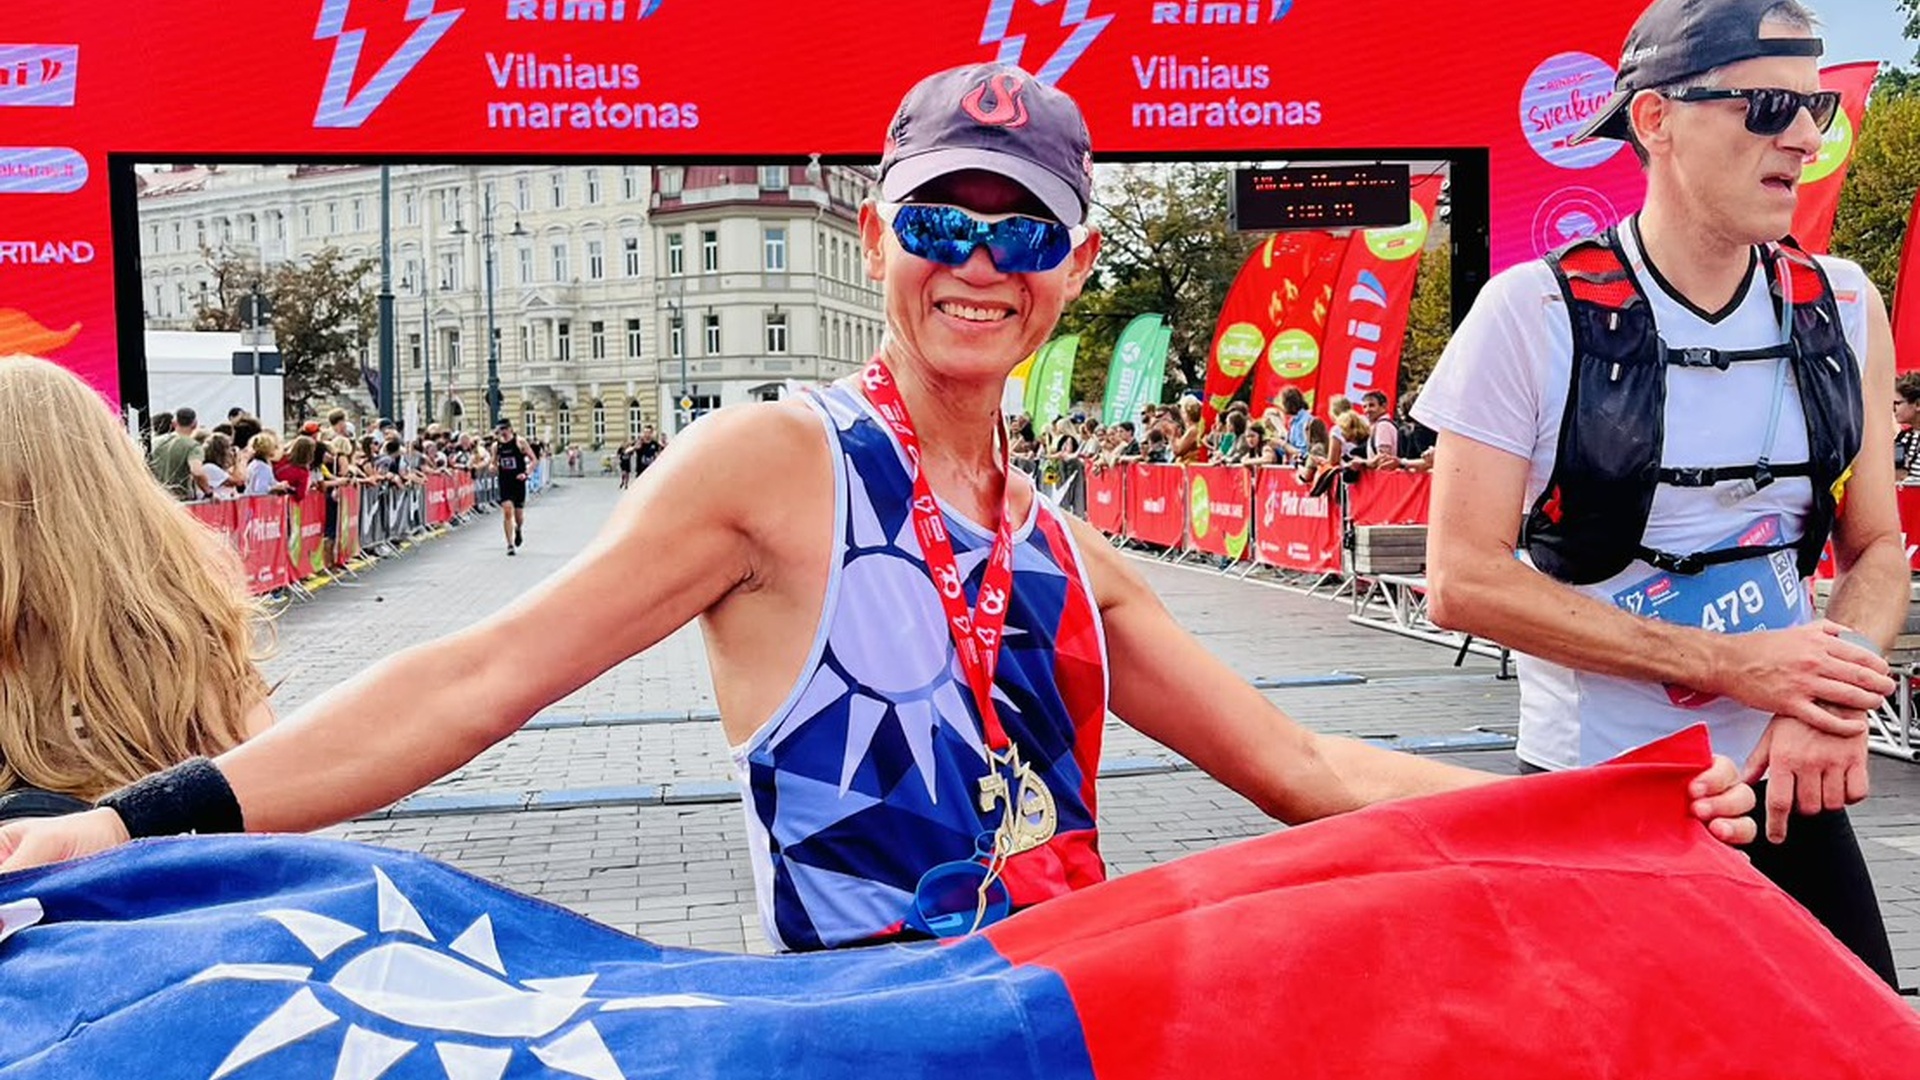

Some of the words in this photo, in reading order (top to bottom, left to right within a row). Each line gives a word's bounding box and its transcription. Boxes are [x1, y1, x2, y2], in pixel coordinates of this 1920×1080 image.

[485, 52, 641, 89] Vilniaus
[1131, 55, 1271, 90] Vilniaus
[486, 96, 700, 129] maratonas
[1131, 96, 1322, 127] maratonas
[1701, 579, 1764, 633] 479
